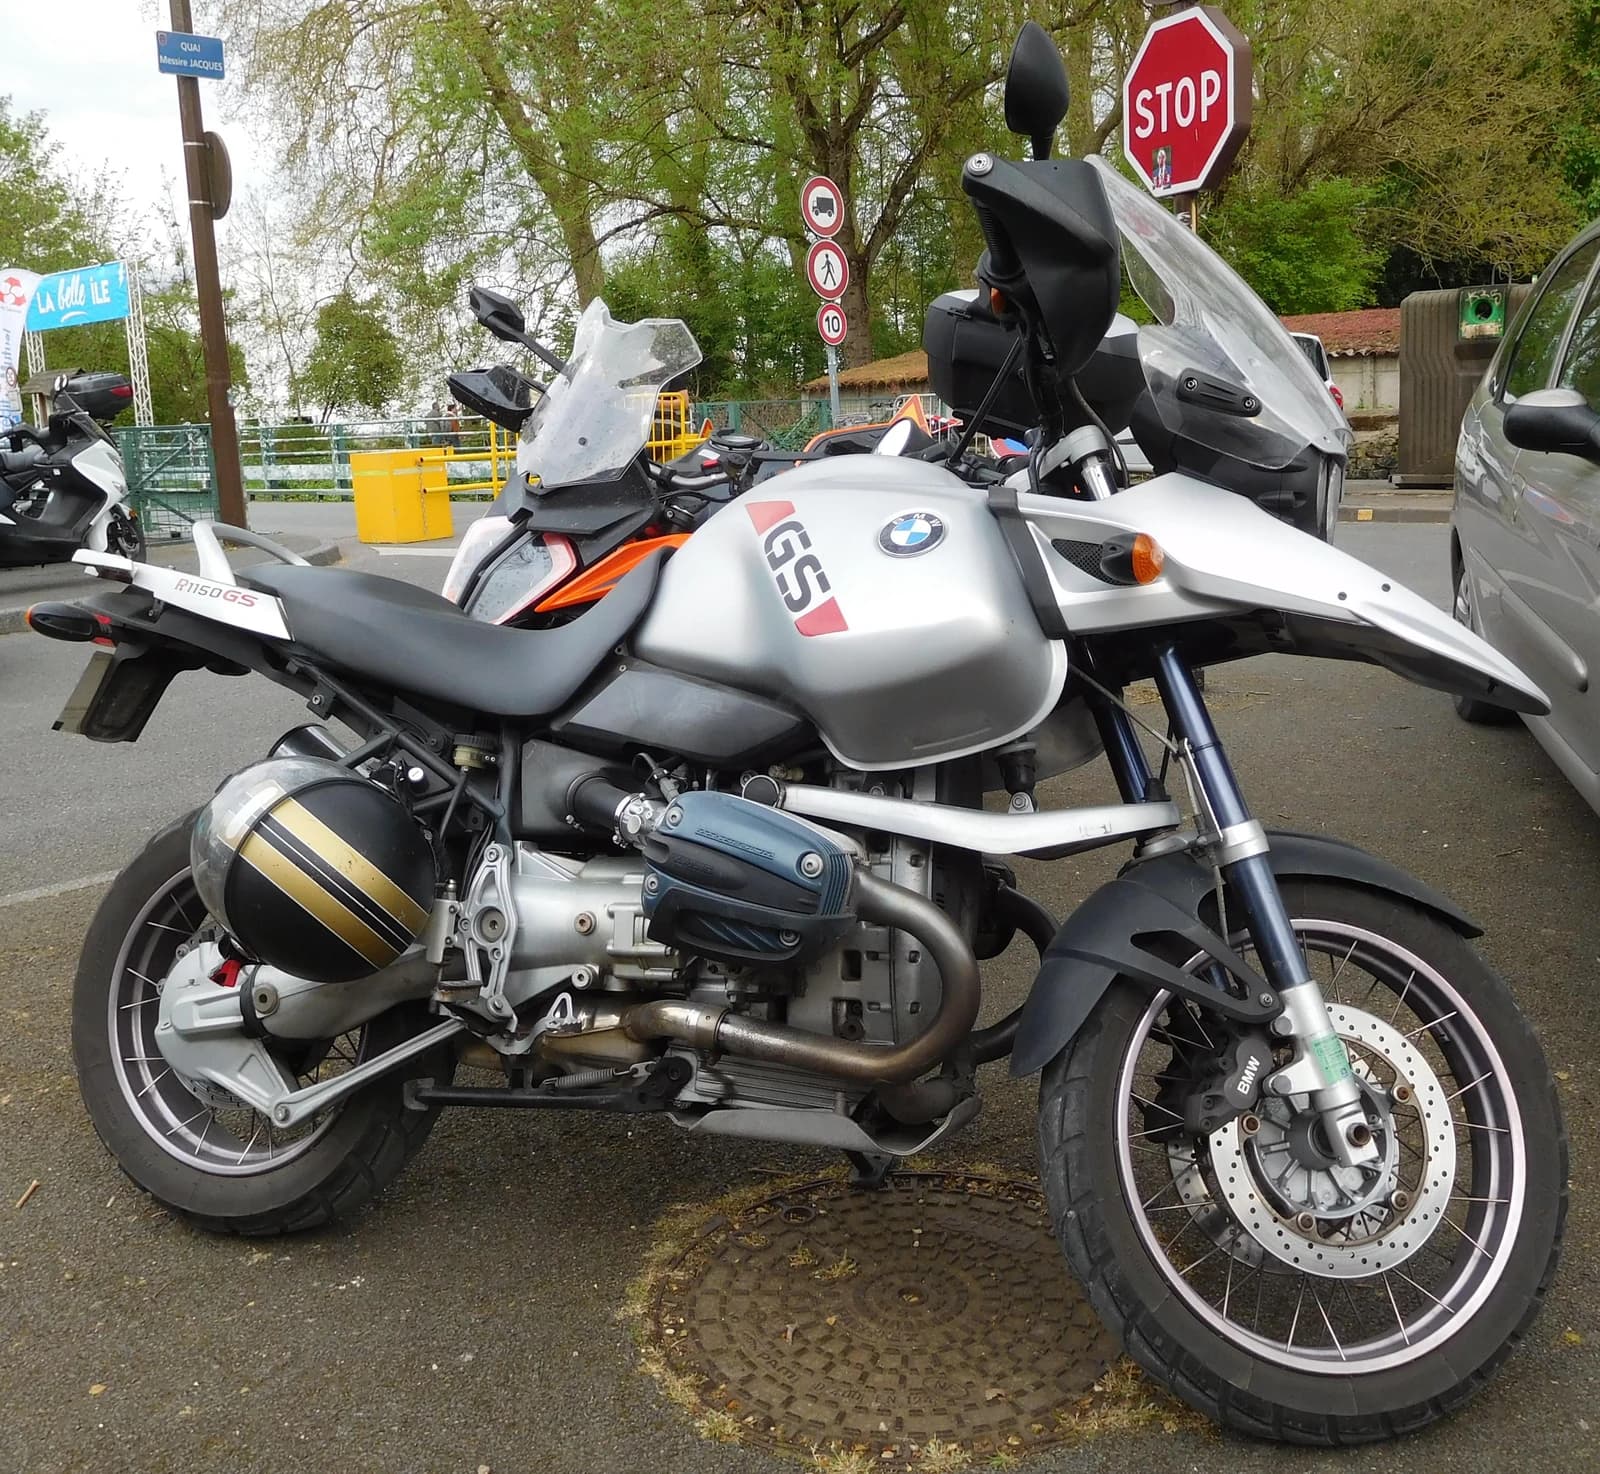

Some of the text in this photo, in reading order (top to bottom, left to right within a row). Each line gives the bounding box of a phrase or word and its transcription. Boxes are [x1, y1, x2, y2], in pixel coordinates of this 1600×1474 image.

[159, 54, 224, 72] Messire JACQUES
[180, 41, 201, 53] QUAI
[1135, 69, 1221, 139] STOP
[36, 290, 56, 314] LA
[57, 272, 87, 311] belle
[824, 315, 841, 334] 10
[764, 520, 831, 613] GS
[1236, 1055, 1261, 1096] BMW
